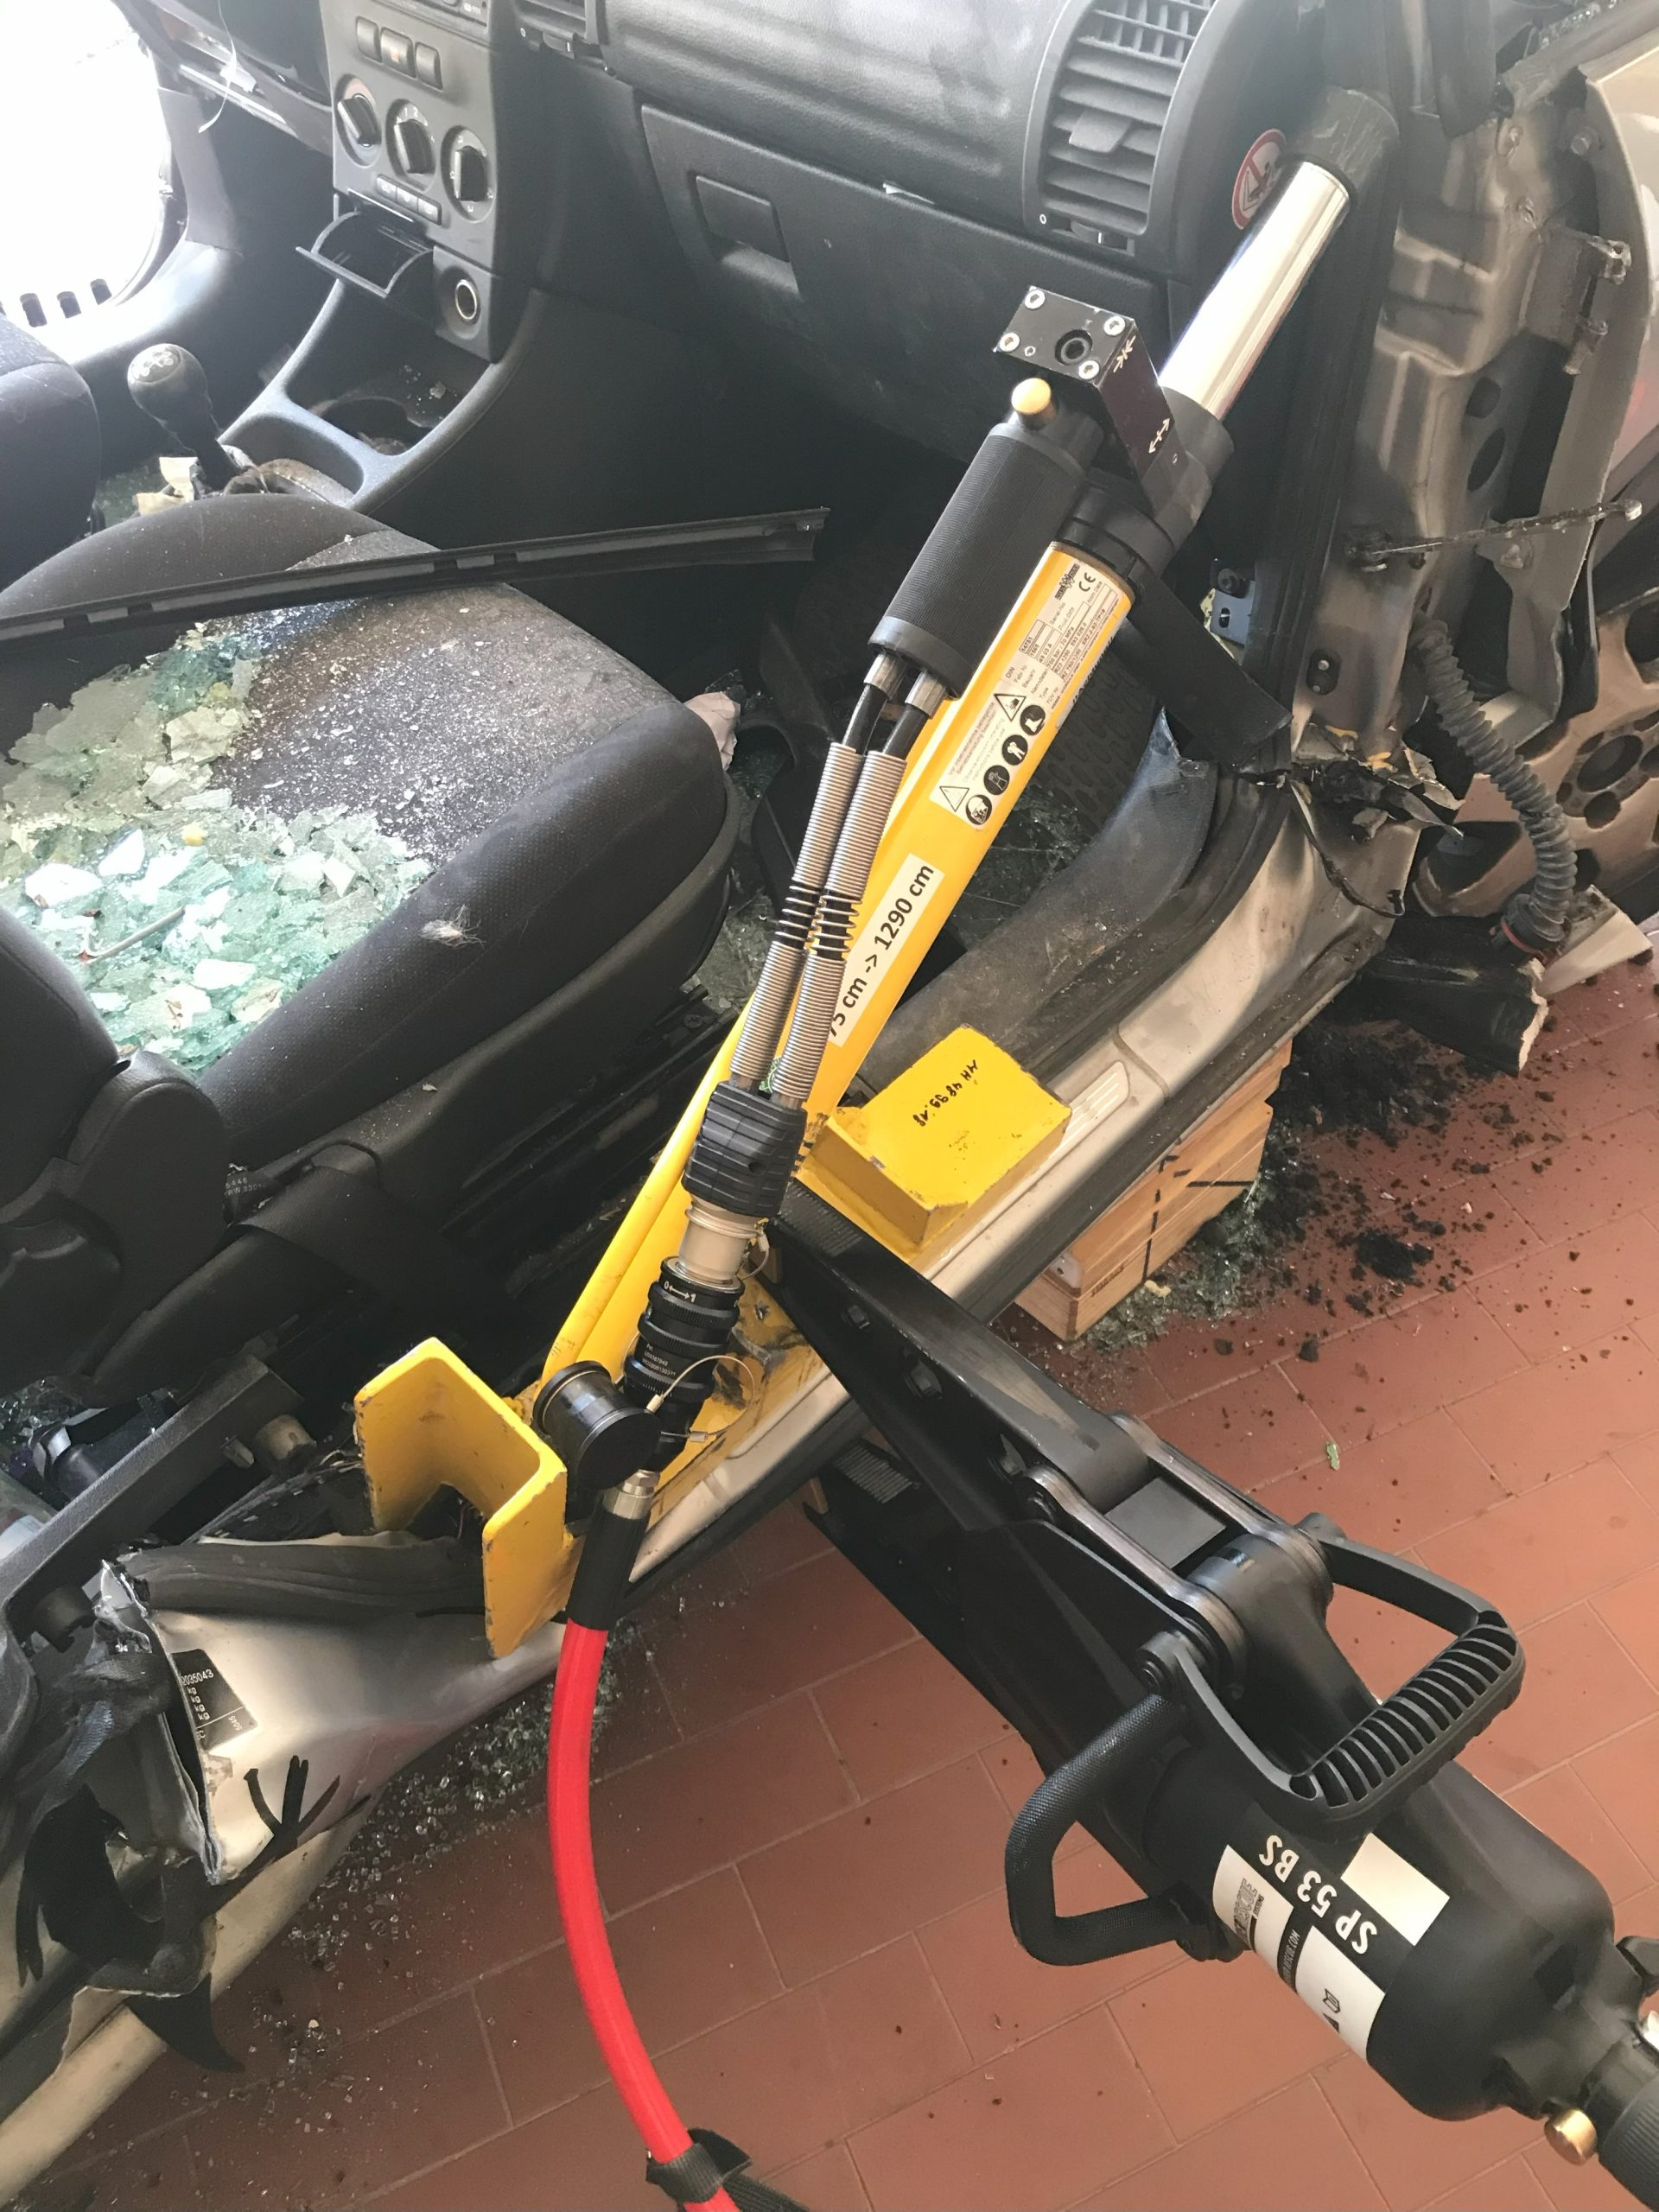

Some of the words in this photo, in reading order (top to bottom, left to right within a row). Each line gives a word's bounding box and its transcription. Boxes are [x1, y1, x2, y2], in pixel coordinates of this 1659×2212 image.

[842, 977, 868, 1008] cm
[874, 898, 913, 950] 1290
[909, 865, 934, 897] cm
[187, 1686, 197, 1695] kg
[190, 1695, 201, 1704] kg
[194, 1704, 206, 1713] kg
[198, 1712, 210, 1721] kg
[1258, 1834, 1300, 1883] BS
[1297, 1870, 1337, 1918] 53
[1335, 1910, 1377, 1955] SP
